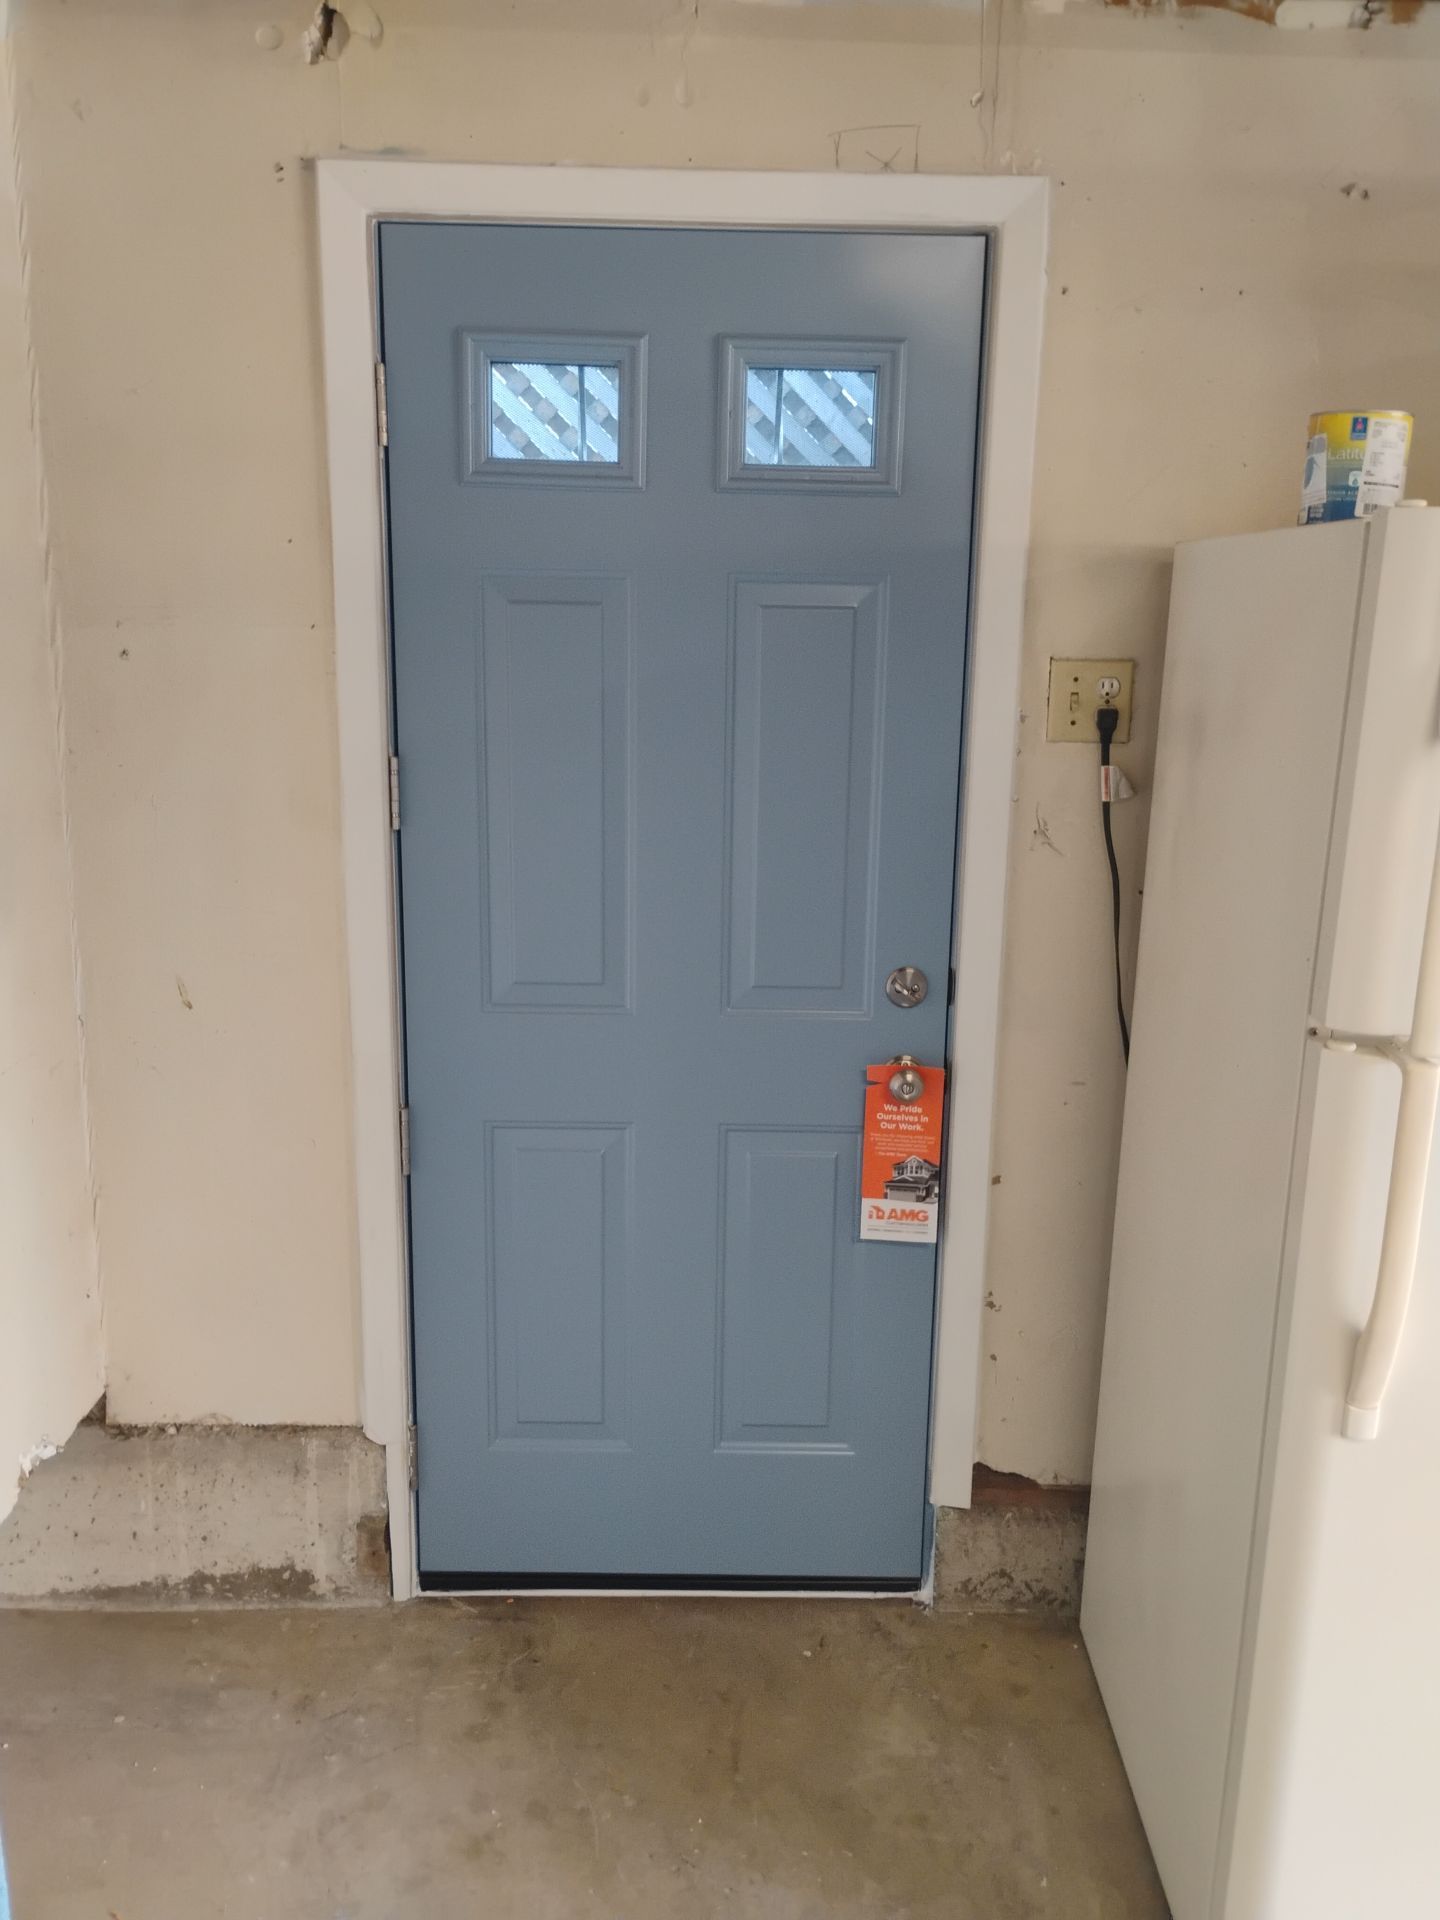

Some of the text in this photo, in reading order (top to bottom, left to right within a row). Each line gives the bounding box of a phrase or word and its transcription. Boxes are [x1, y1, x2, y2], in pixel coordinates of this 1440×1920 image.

[883, 1104, 923, 1113] We Pride
[876, 1113, 918, 1122] Ourselves
[898, 1122, 924, 1131] Work.
[887, 1207, 929, 1222] AMG
